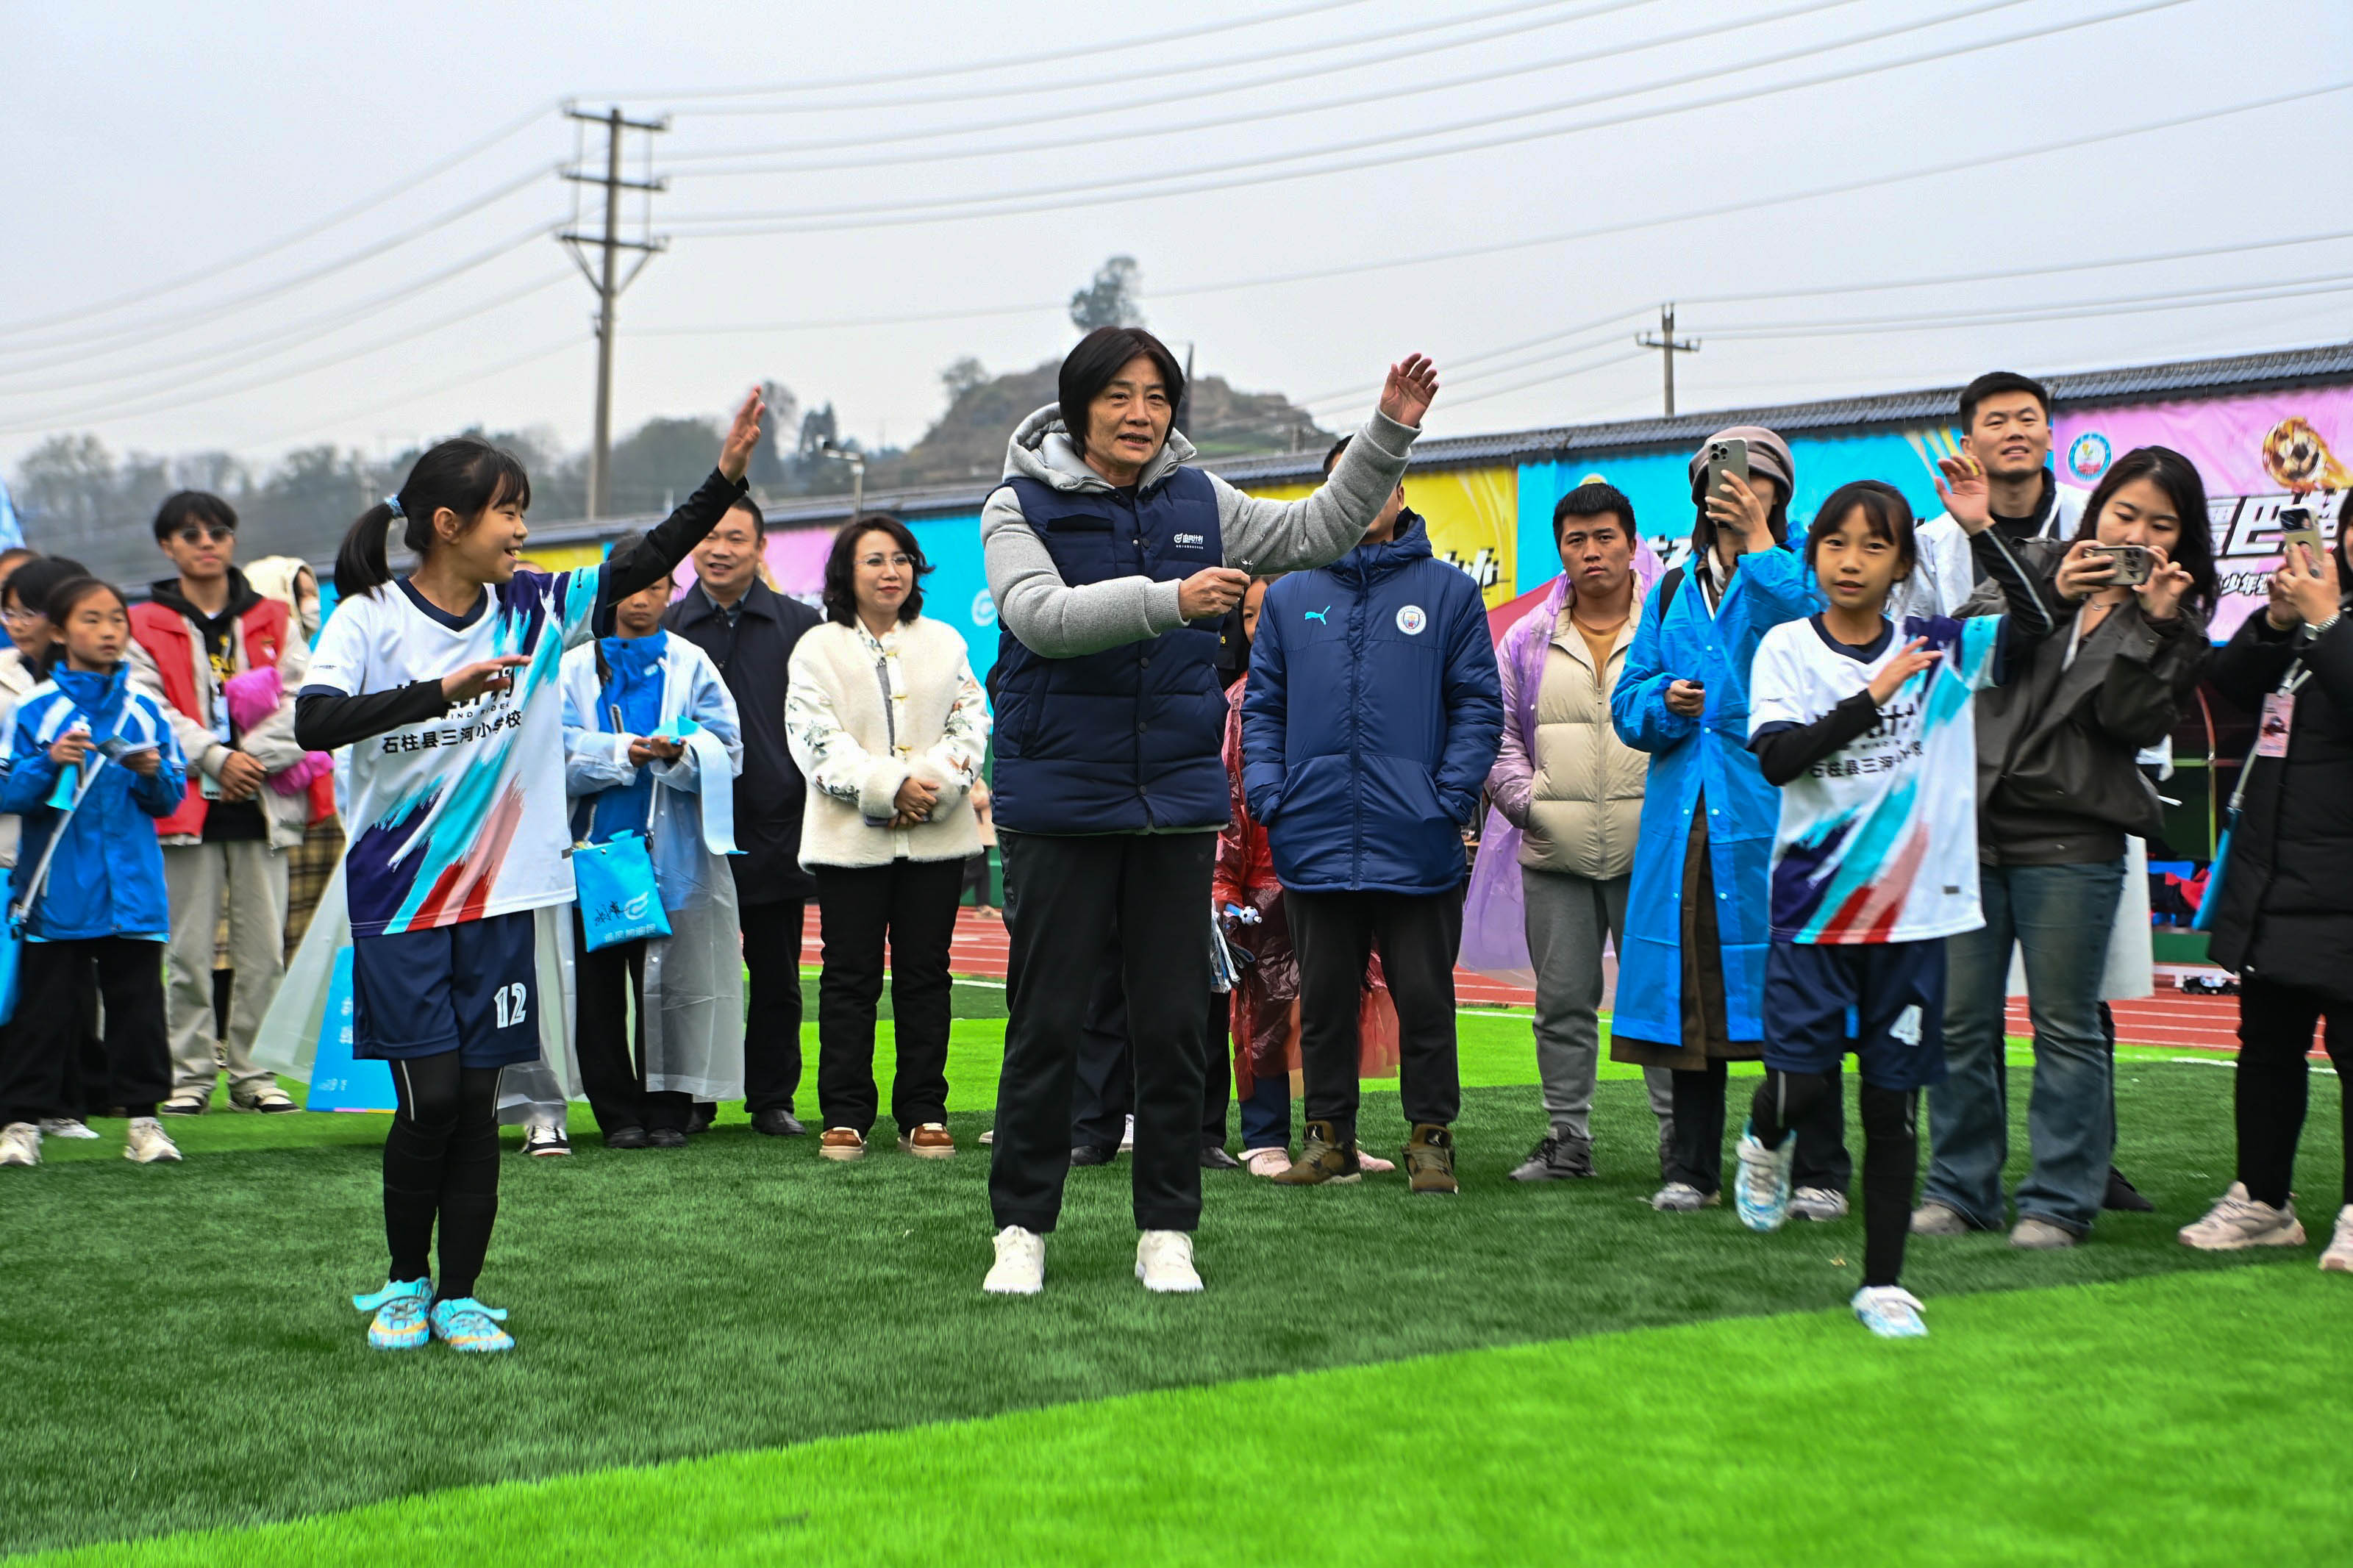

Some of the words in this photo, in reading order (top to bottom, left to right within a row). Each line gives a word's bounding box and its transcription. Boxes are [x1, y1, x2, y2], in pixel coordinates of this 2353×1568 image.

[382, 709, 522, 754] 石柱县三河小学校
[493, 981, 527, 1029] 12
[1888, 1003, 1924, 1047] 4
